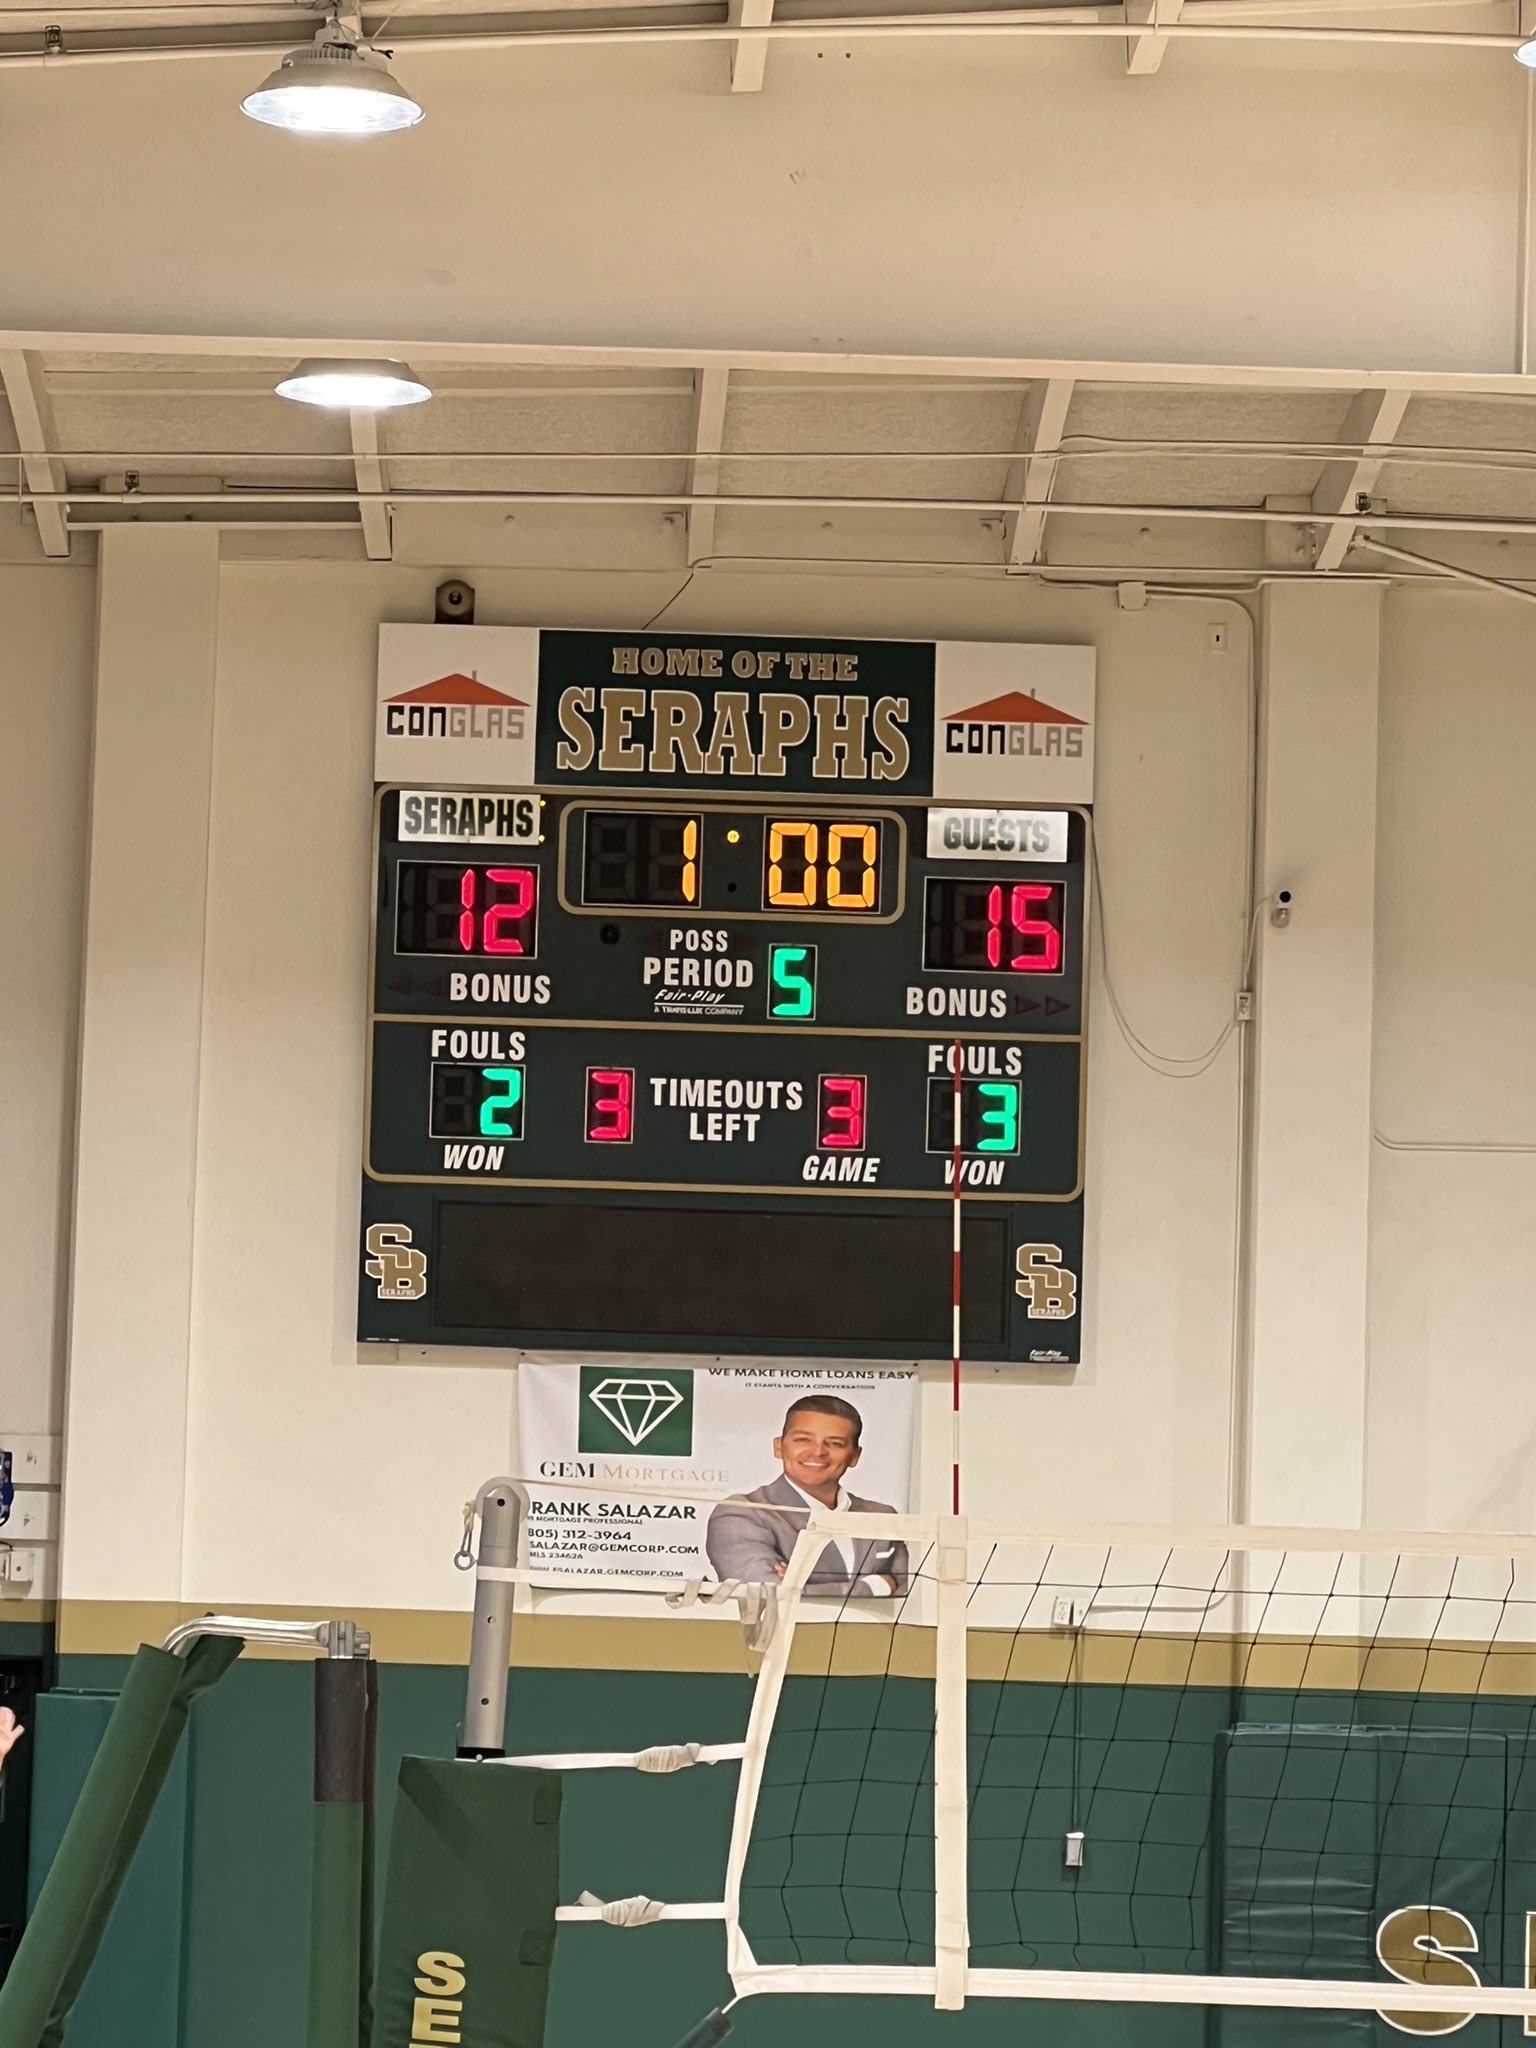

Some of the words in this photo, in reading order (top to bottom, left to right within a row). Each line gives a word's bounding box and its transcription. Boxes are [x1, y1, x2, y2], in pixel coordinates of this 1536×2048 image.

[611, 647, 723, 677] HOME
[731, 650, 780, 679] OF
[785, 652, 858, 681] THE
[556, 685, 910, 781] SERAPHS
[404, 796, 534, 838] SERAPHS
[943, 816, 1051, 853] GUESTS
[459, 868, 535, 954] 12
[669, 929, 728, 952] POSS
[987, 884, 1060, 971] 15
[643, 957, 753, 987] PERIOD
[772, 947, 812, 1016] 5
[450, 972, 551, 1004] BONUS
[906, 987, 1007, 1018] BONUS
[705, 1007, 744, 1015] COMPANY
[431, 1029, 526, 1061] FOULS
[928, 1045, 1022, 1076] FOULS
[480, 1068, 521, 1136] 2
[589, 1071, 630, 1139] 3
[649, 1078, 803, 1110] TIMEOUTS
[689, 1112, 761, 1142] LEFT
[821, 1078, 861, 1146] 3
[976, 1083, 1018, 1151] 3
[443, 1145, 505, 1171] WON
[802, 1155, 880, 1183] GAME
[944, 1160, 1005, 1186] WON
[708, 1367, 730, 1377] WE
[734, 1368, 776, 1378] MAKE
[780, 1369, 823, 1379] HOME
[827, 1370, 874, 1380] LOANS
[878, 1371, 914, 1380] EASY
[539, 1461, 595, 1478] GEM
[532, 1501, 592, 1517] RANK
[597, 1503, 697, 1520] SALAZAR
[536, 1515, 581, 1523] MORTGAGE
[583, 1517, 643, 1526] PROFESSIONAL
[527, 1528, 558, 1540] 805)
[562, 1529, 631, 1540] 312-3964
[529, 1541, 699, 1555] SALAZAR@GEMCORP.COM
[529, 1551, 546, 1559] MLS
[1376, 1905, 1536, 2037] S
[409, 1951, 466, 2048] SE
